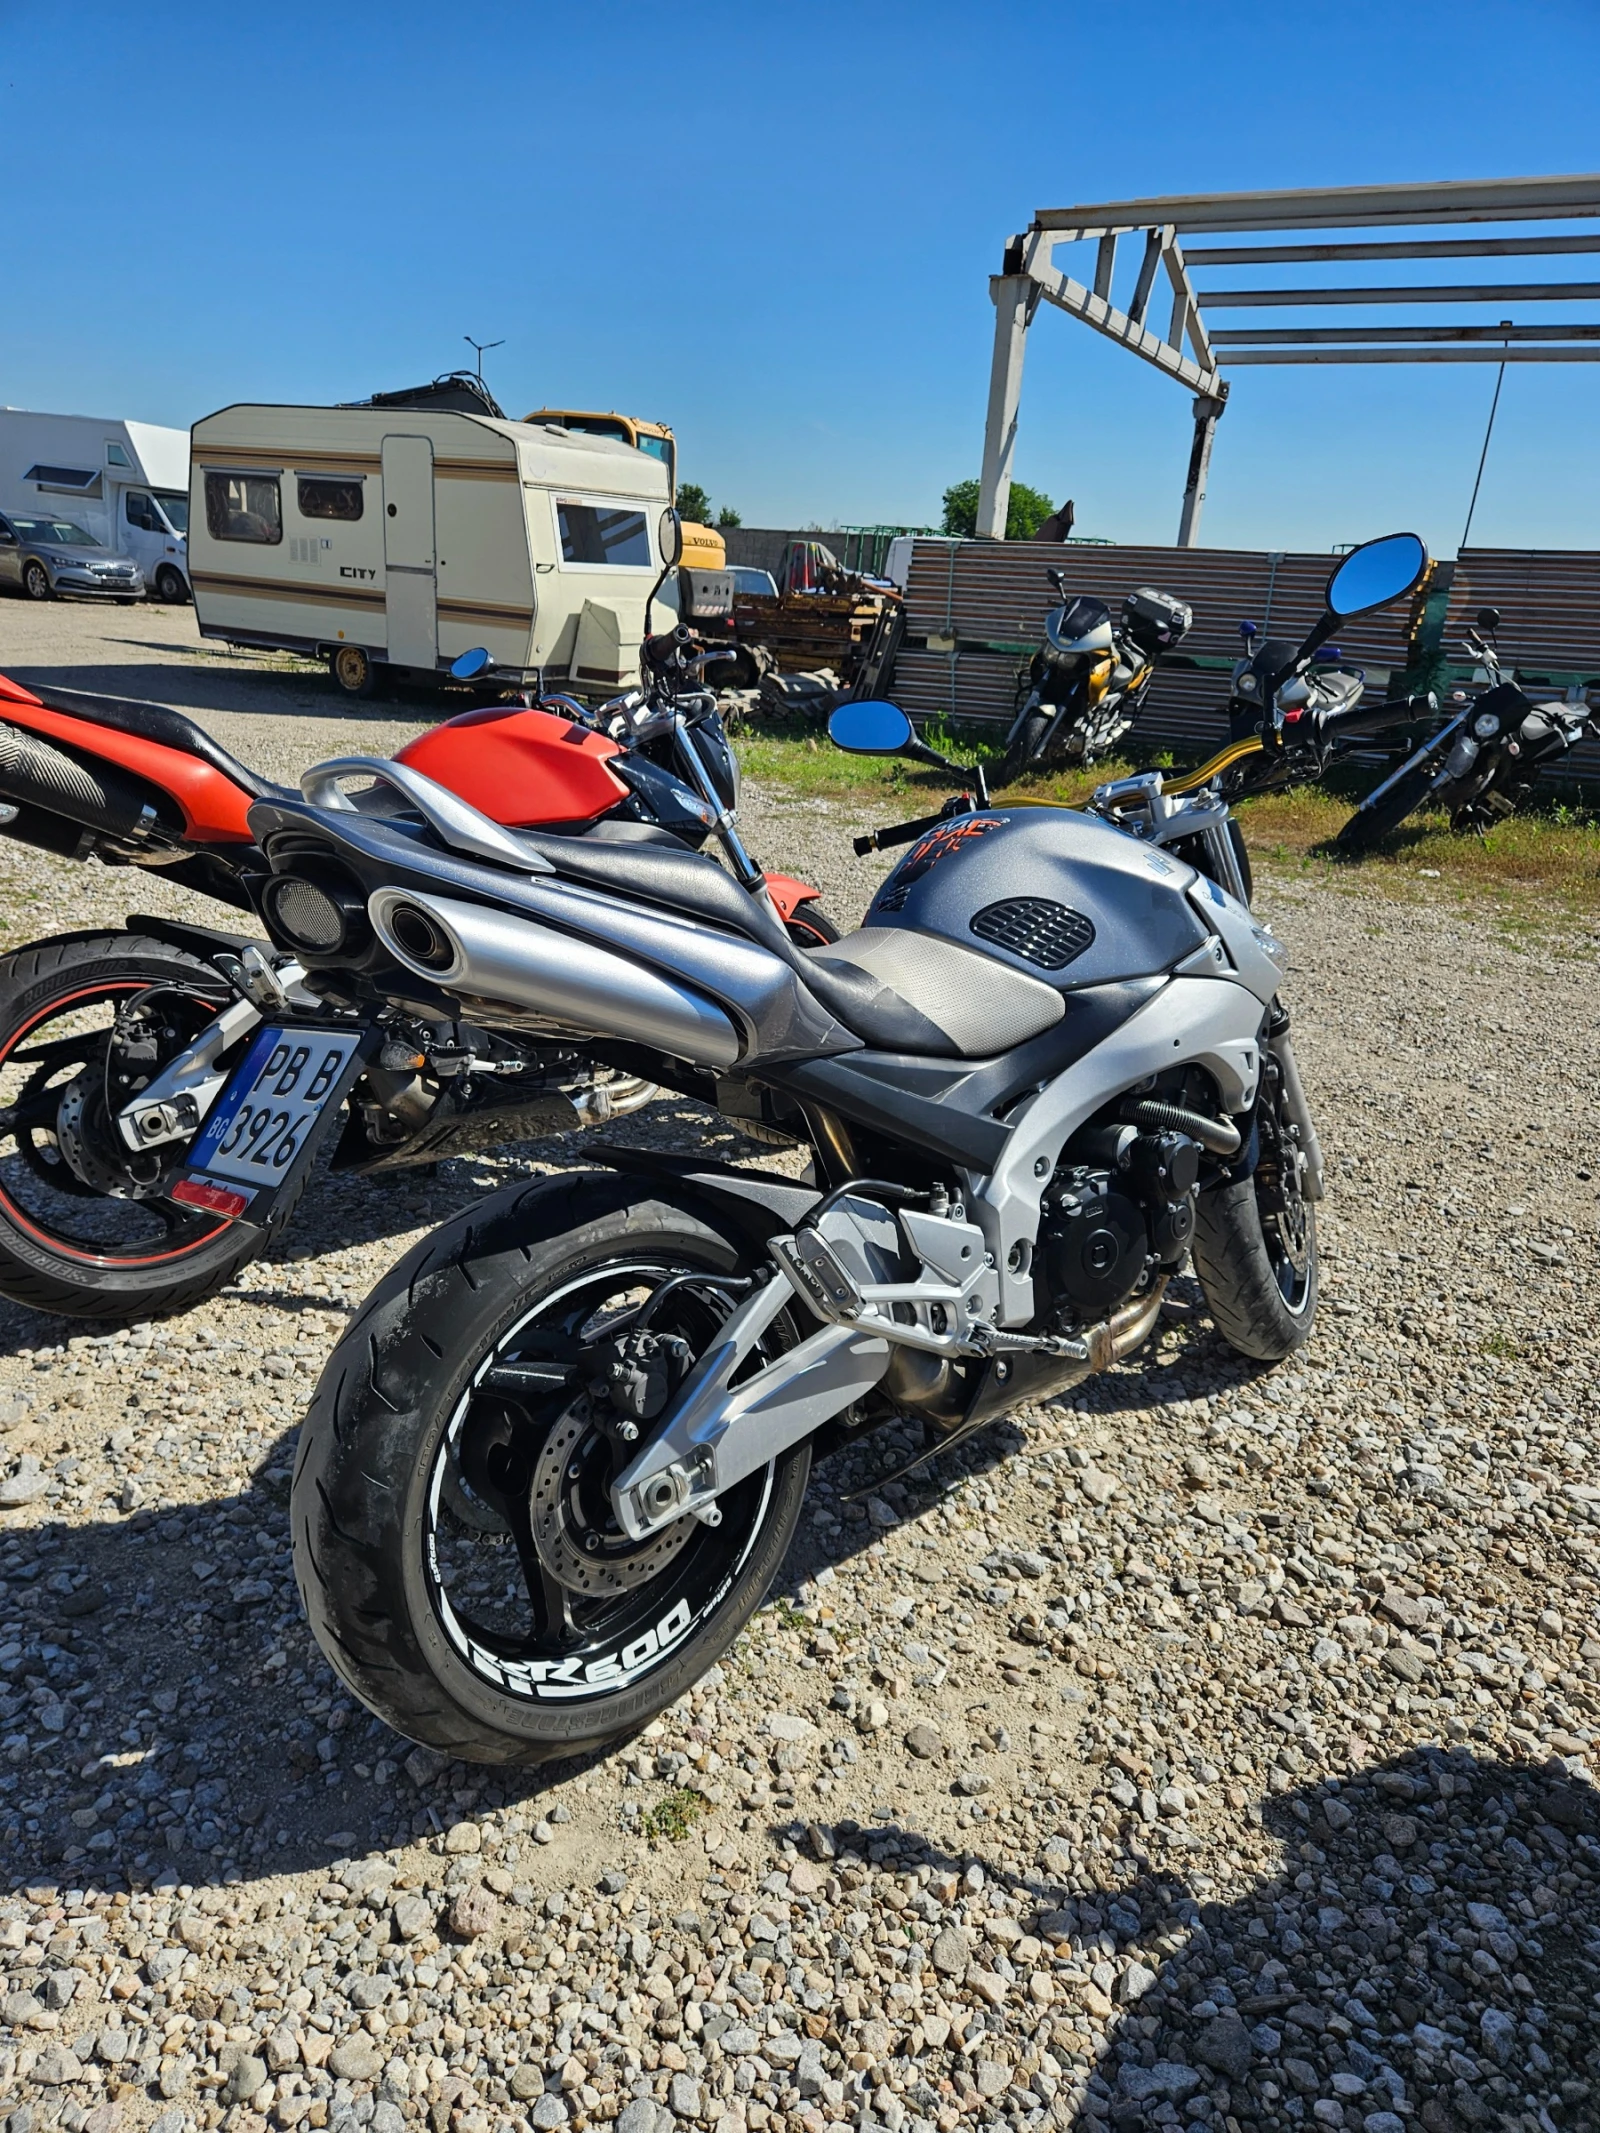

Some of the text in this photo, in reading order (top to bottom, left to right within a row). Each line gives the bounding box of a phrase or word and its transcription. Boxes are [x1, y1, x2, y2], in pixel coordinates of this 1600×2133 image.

[693, 537, 718, 547] VOLVO
[339, 566, 376, 580] CITY
[252, 1044, 344, 1102] PB B
[206, 1116, 231, 1140] BG
[218, 1105, 310, 1169] 3926
[468, 1597, 691, 1684] GSR600
[505, 1667, 681, 1731] BRIDGESTONE
